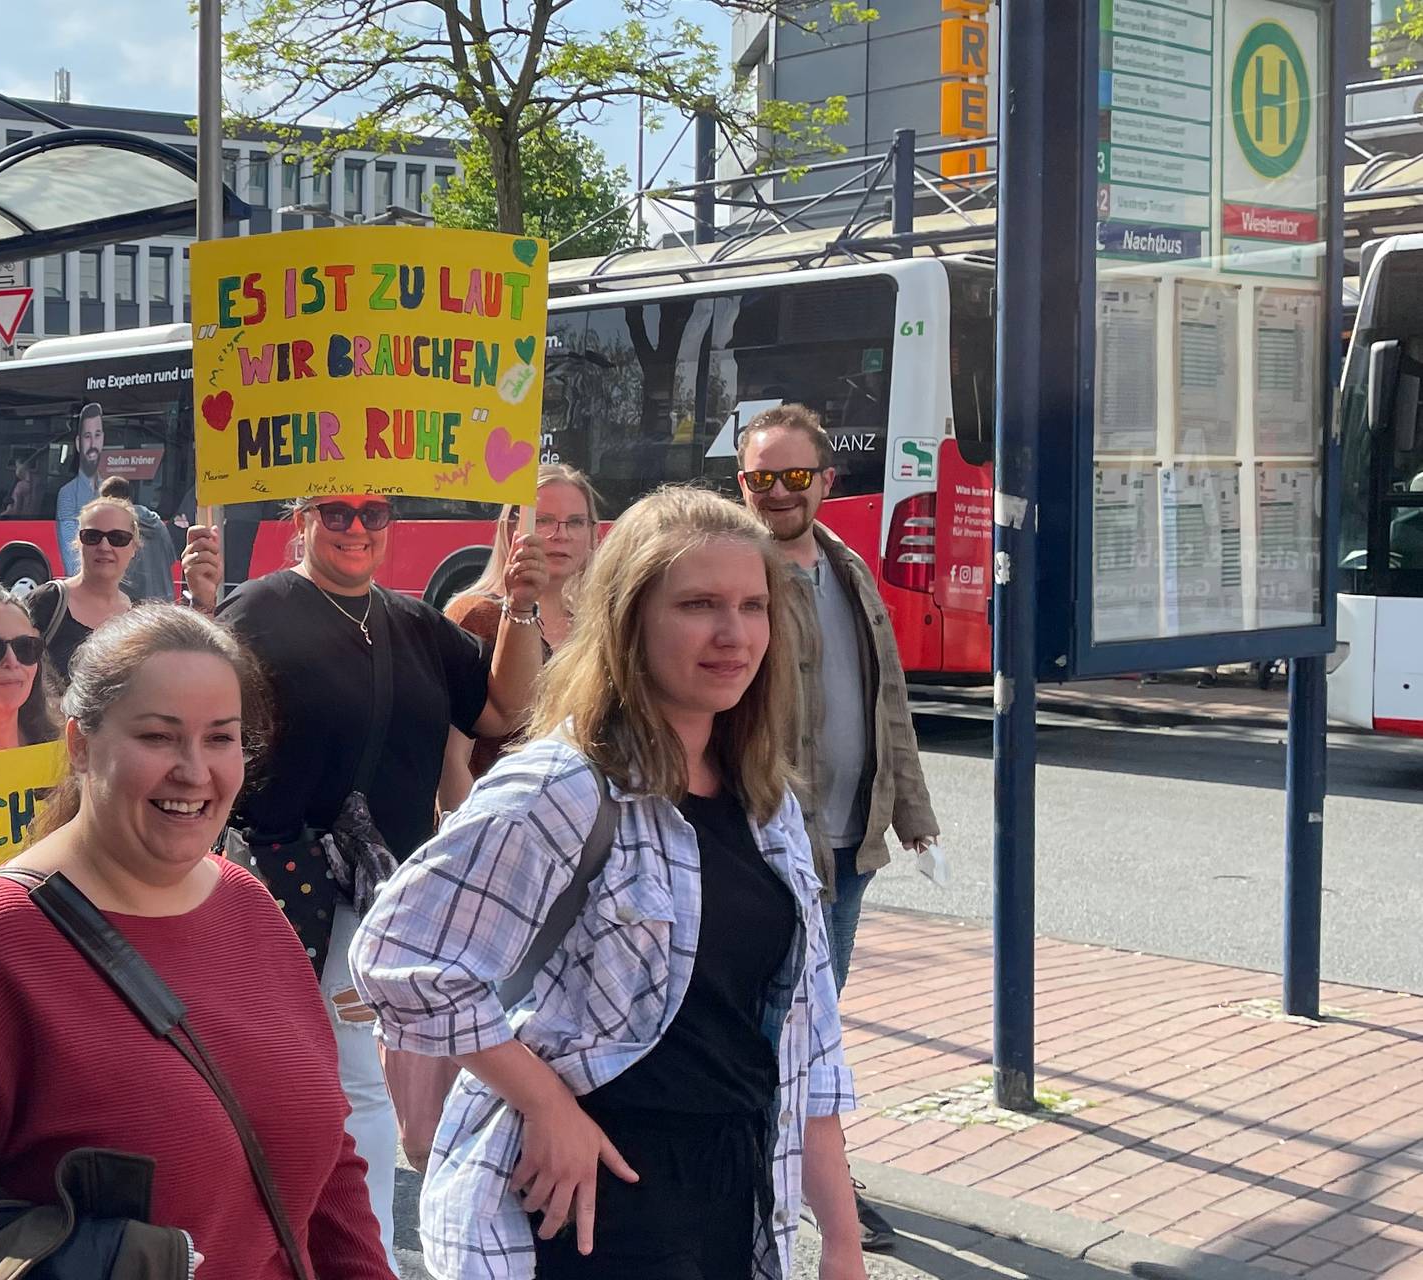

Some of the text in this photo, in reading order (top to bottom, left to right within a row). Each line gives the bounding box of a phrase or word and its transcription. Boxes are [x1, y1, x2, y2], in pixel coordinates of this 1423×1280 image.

[1241, 210, 1300, 235] Westentor
[1123, 230, 1182, 254] Nachtbus
[284, 265, 355, 319] IST
[369, 263, 425, 310] ZU
[440, 266, 531, 320] LAUT
[900, 321, 924, 336] 61
[238, 334, 499, 387] WIR BRAUCHEN
[87, 377, 106, 390] Ihre
[107, 373, 151, 389] Experten
[154, 367, 178, 382] rund
[238, 412, 345, 470] MEHR
[107, 456, 130, 465] Stefan
[954, 503, 967, 513] Wir
